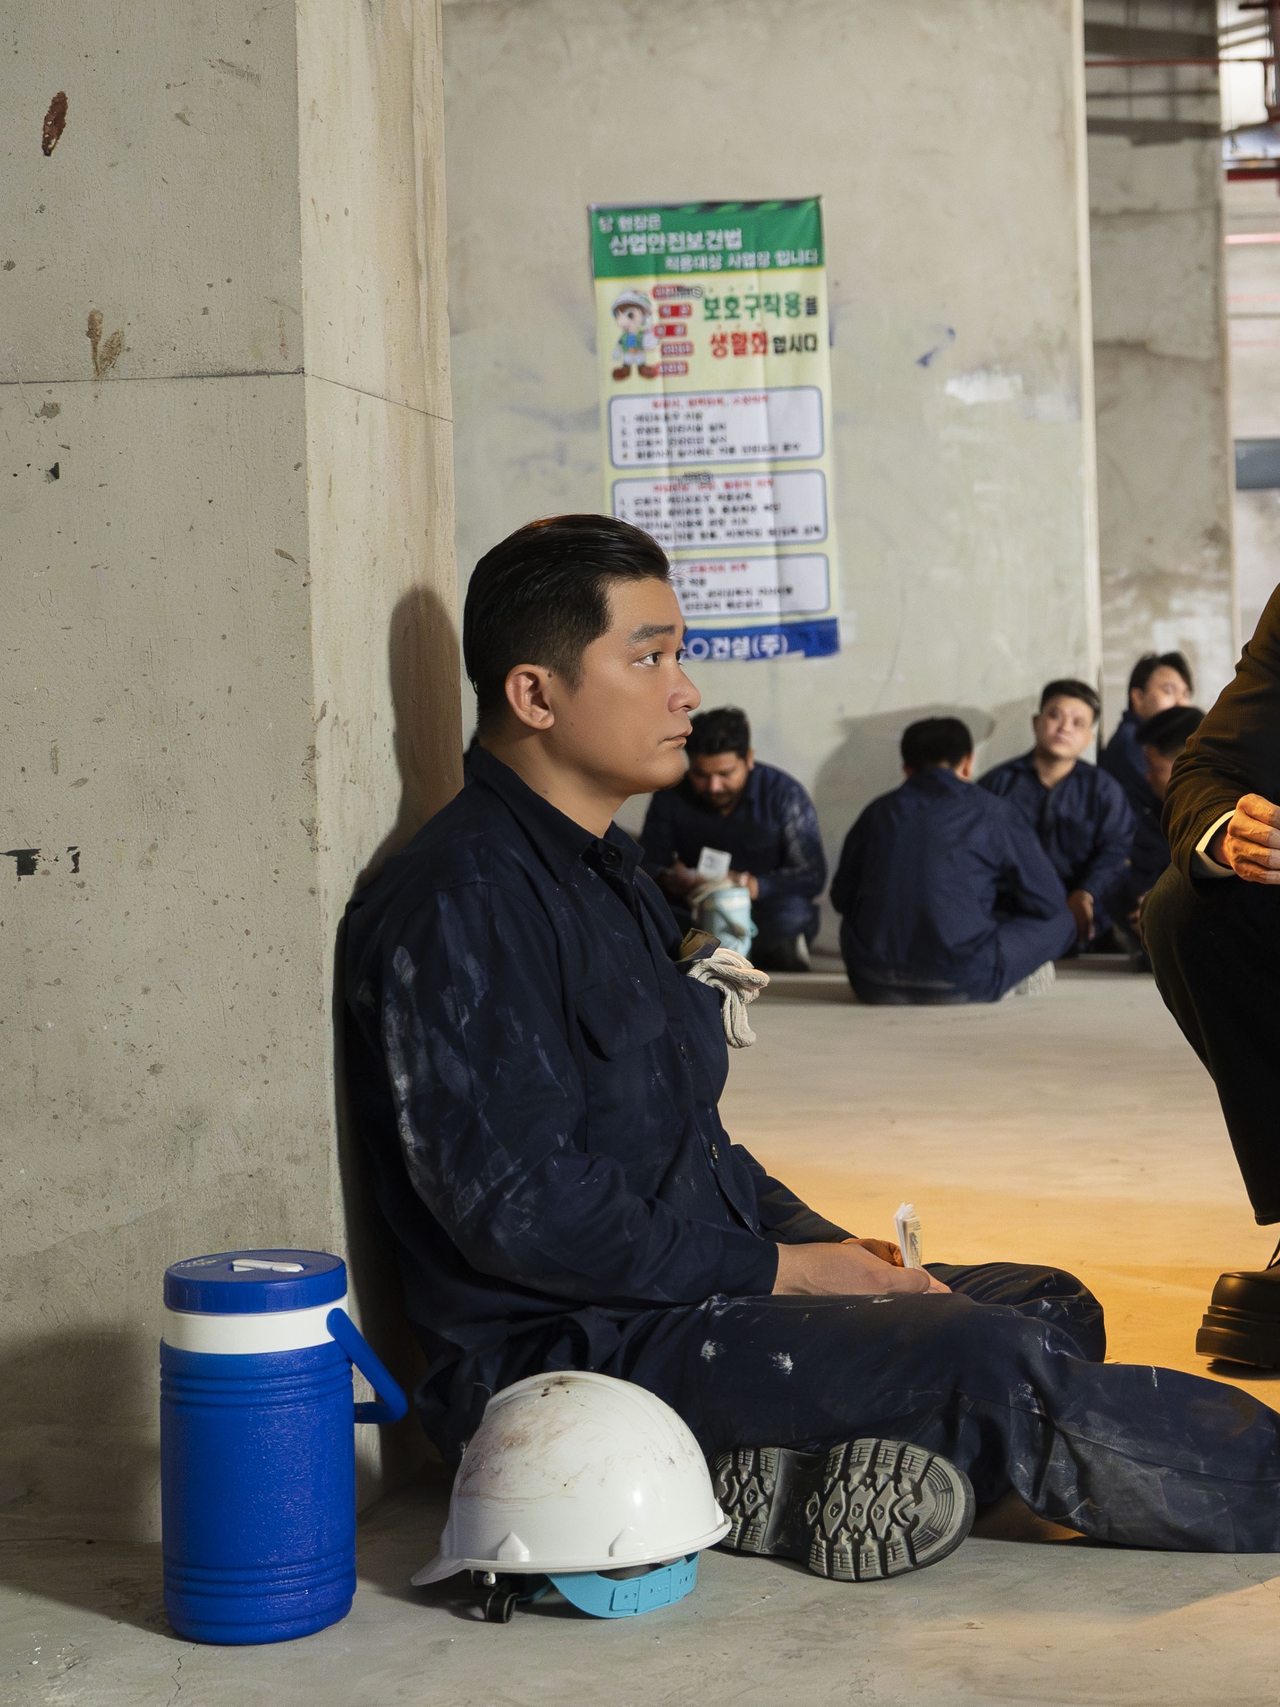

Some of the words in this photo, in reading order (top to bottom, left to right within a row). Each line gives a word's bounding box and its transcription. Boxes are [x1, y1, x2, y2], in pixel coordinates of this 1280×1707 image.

[609, 227, 742, 256] 산업안전보건법
[665, 253, 722, 272] 적용대상
[727, 250, 770, 269] 사업장
[774, 248, 818, 267] 입니다
